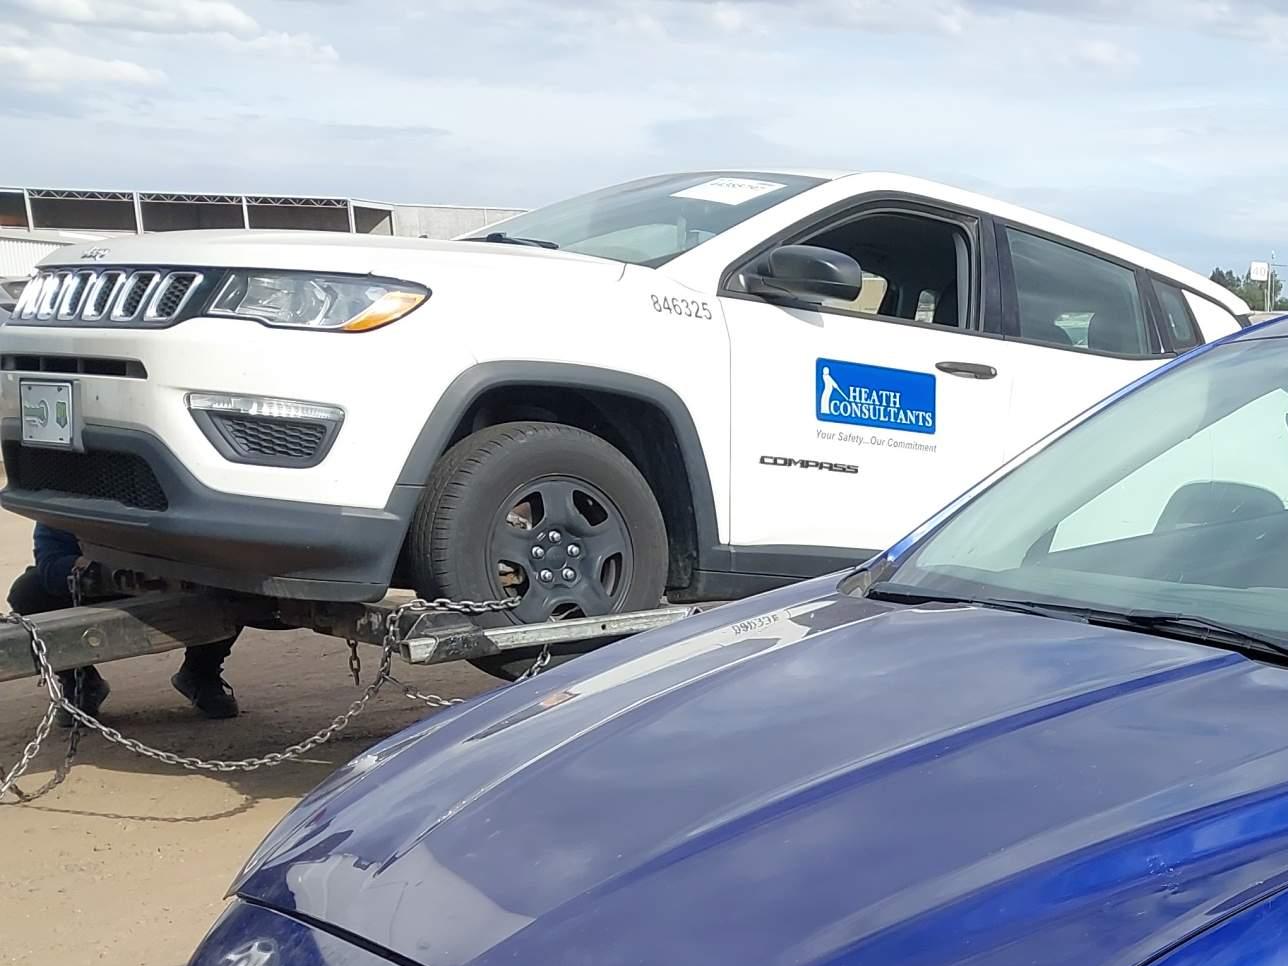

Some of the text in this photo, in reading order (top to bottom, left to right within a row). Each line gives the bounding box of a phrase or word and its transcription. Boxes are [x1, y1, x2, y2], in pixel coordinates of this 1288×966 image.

[650, 294, 712, 320] 846325
[848, 386, 901, 408] HEATH
[830, 399, 933, 427] CONSULTANTS
[816, 429, 835, 440] Your
[887, 438, 937, 453] Commitment
[759, 455, 859, 474] COMPASS
